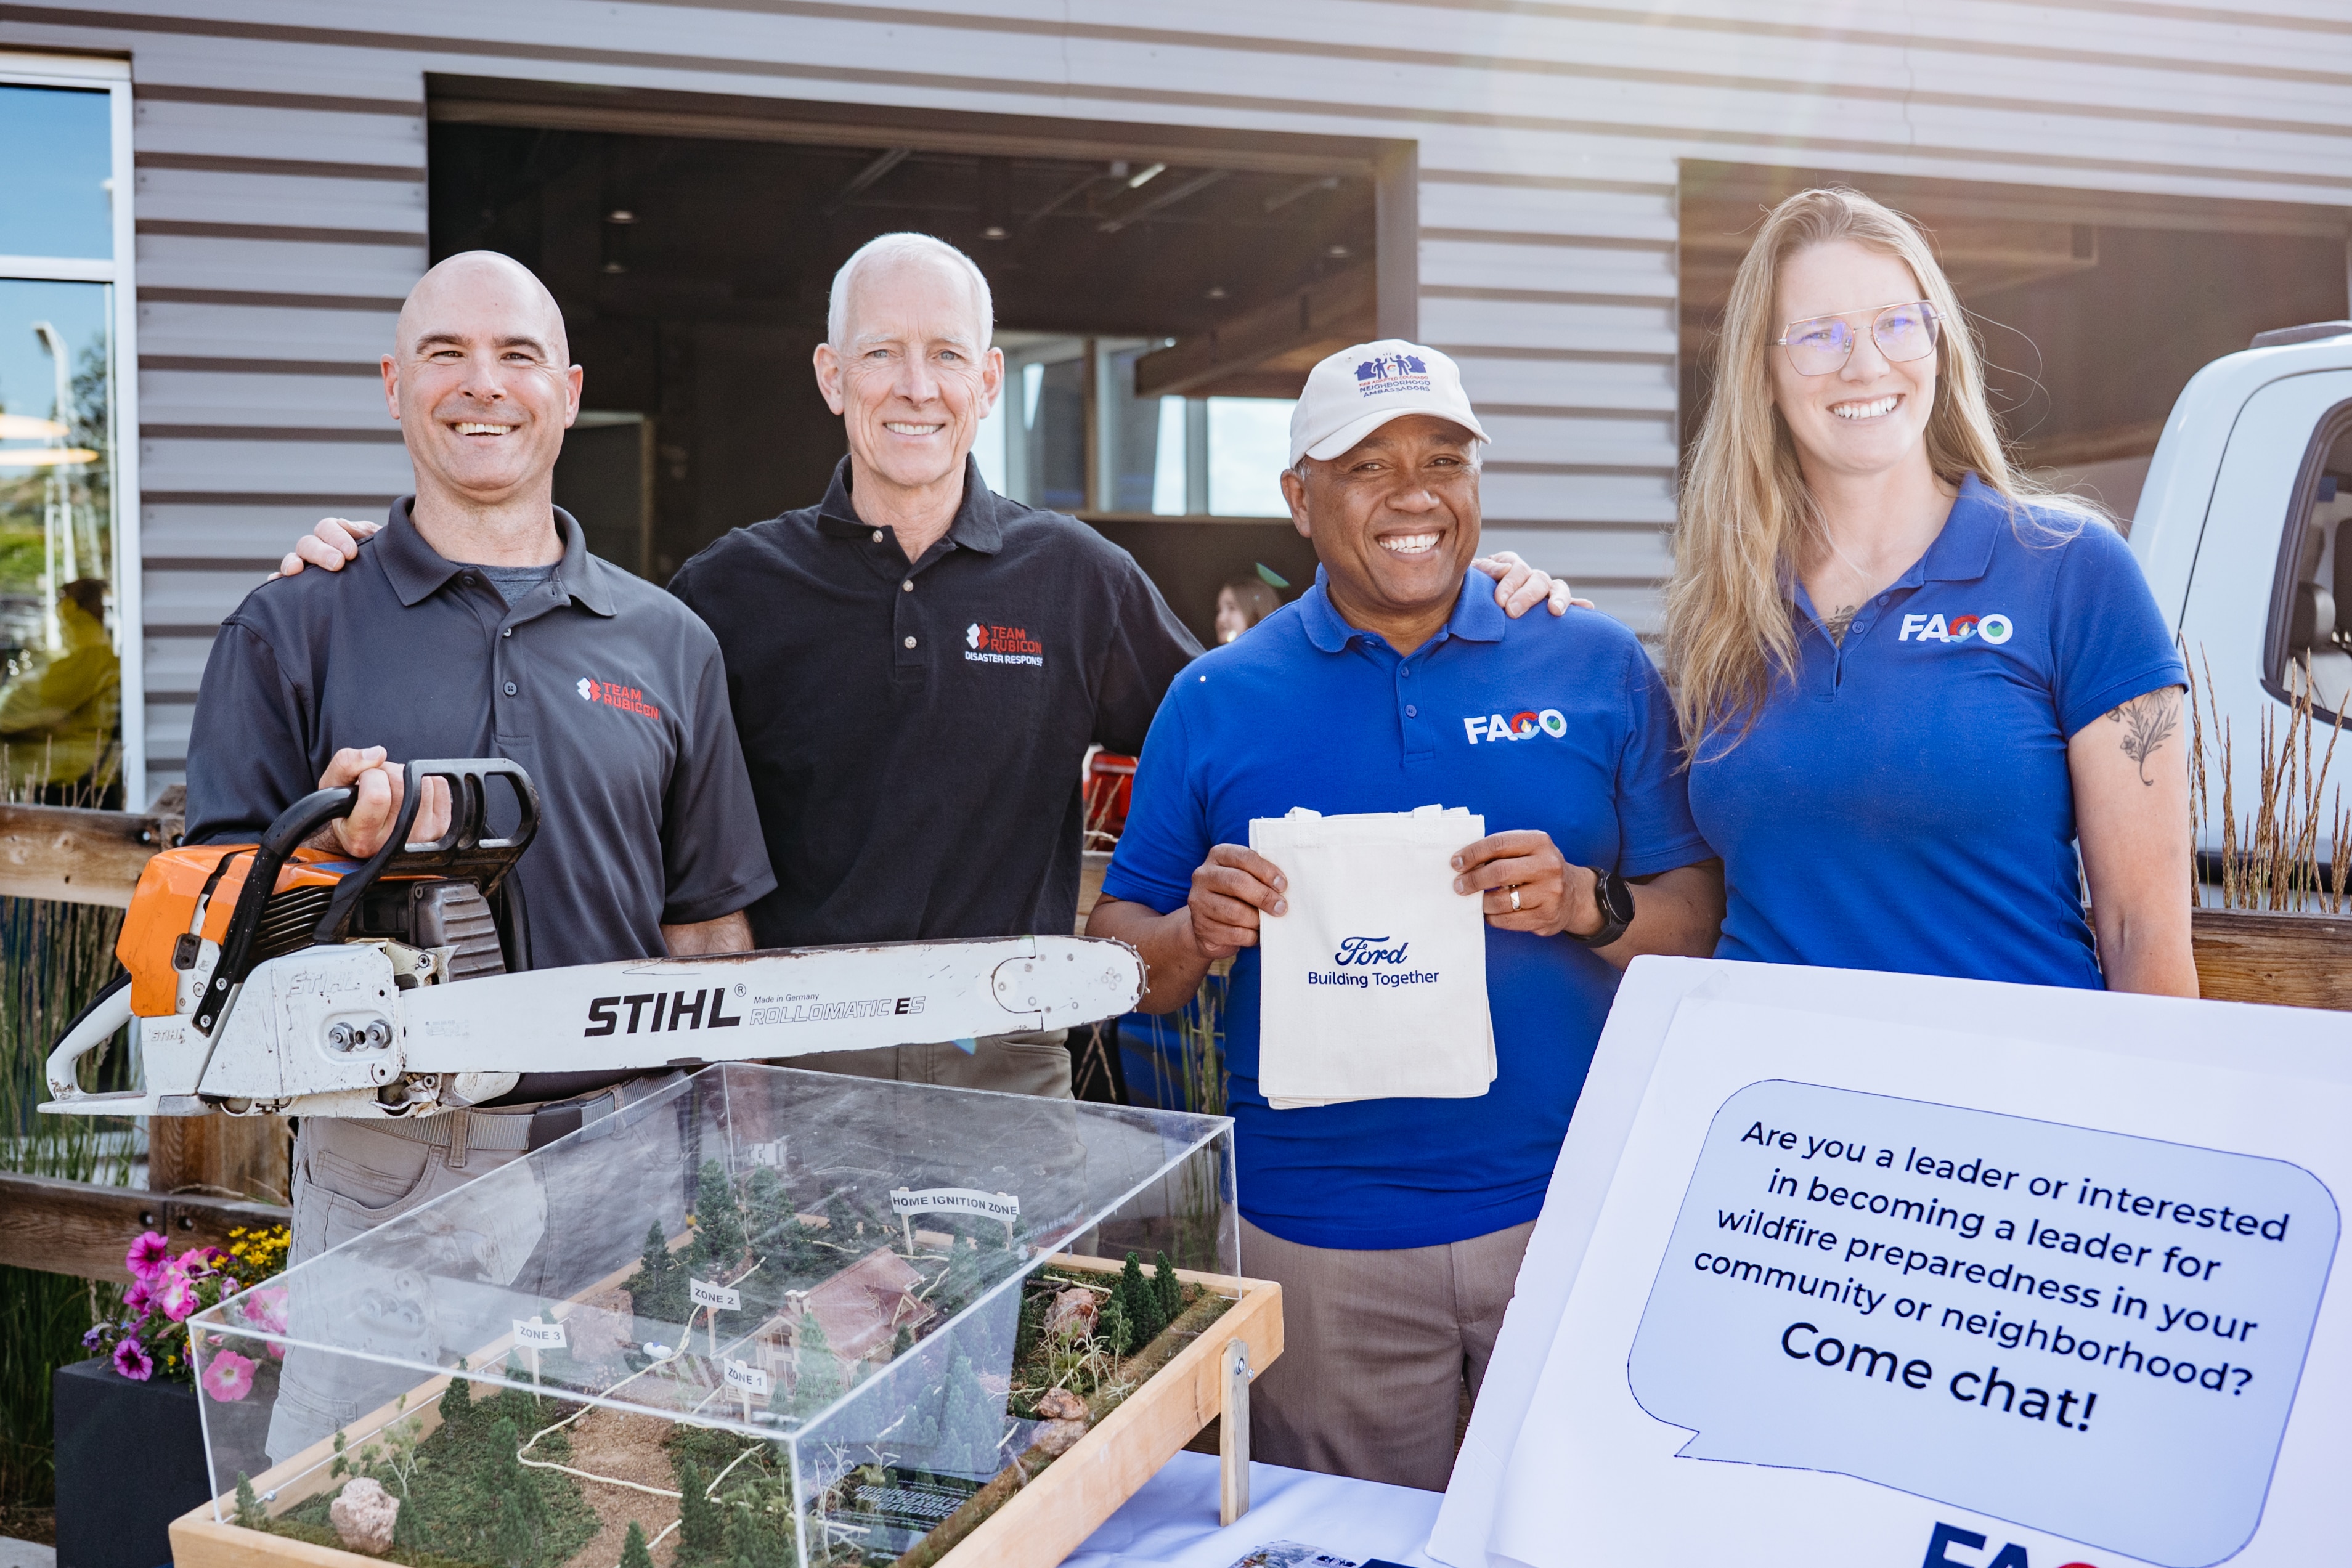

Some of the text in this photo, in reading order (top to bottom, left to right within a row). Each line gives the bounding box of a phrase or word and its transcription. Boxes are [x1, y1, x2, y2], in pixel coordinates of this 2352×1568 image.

[1359, 380, 1430, 393] NEIGHBORHOOD
[1363, 386, 1430, 398] AMBASSADORS
[991, 626, 1026, 640] TEAM
[1898, 614, 2013, 644] FACO
[990, 638, 1042, 654] RUBICON
[964, 651, 1004, 664] DISASTER
[602, 682, 642, 702] TEAM
[603, 693, 660, 720] RUBICON
[1463, 709, 1568, 744] FACO
[1335, 936, 1409, 965] Ford
[1308, 970, 1439, 988] Building Together
[754, 996, 774, 1004] Made
[786, 994, 820, 1002] Germany
[749, 996, 926, 1025] ROLLOMATIC ES
[1741, 1121, 2290, 1241] Are you a leader or interested
[892, 1196, 1017, 1215] HOME IGNITION ZONE
[1768, 1168, 2221, 1281] in becoming a leader for
[1718, 1209, 2258, 1342] wildfire preparedness in your
[694, 1288, 723, 1303] ZONE
[1694, 1251, 2253, 1395] community or neighborhood?
[520, 1326, 561, 1340] ZONE 3
[728, 1367, 762, 1386] ZONE 1
[1781, 1322, 2098, 1432] Come chat!
